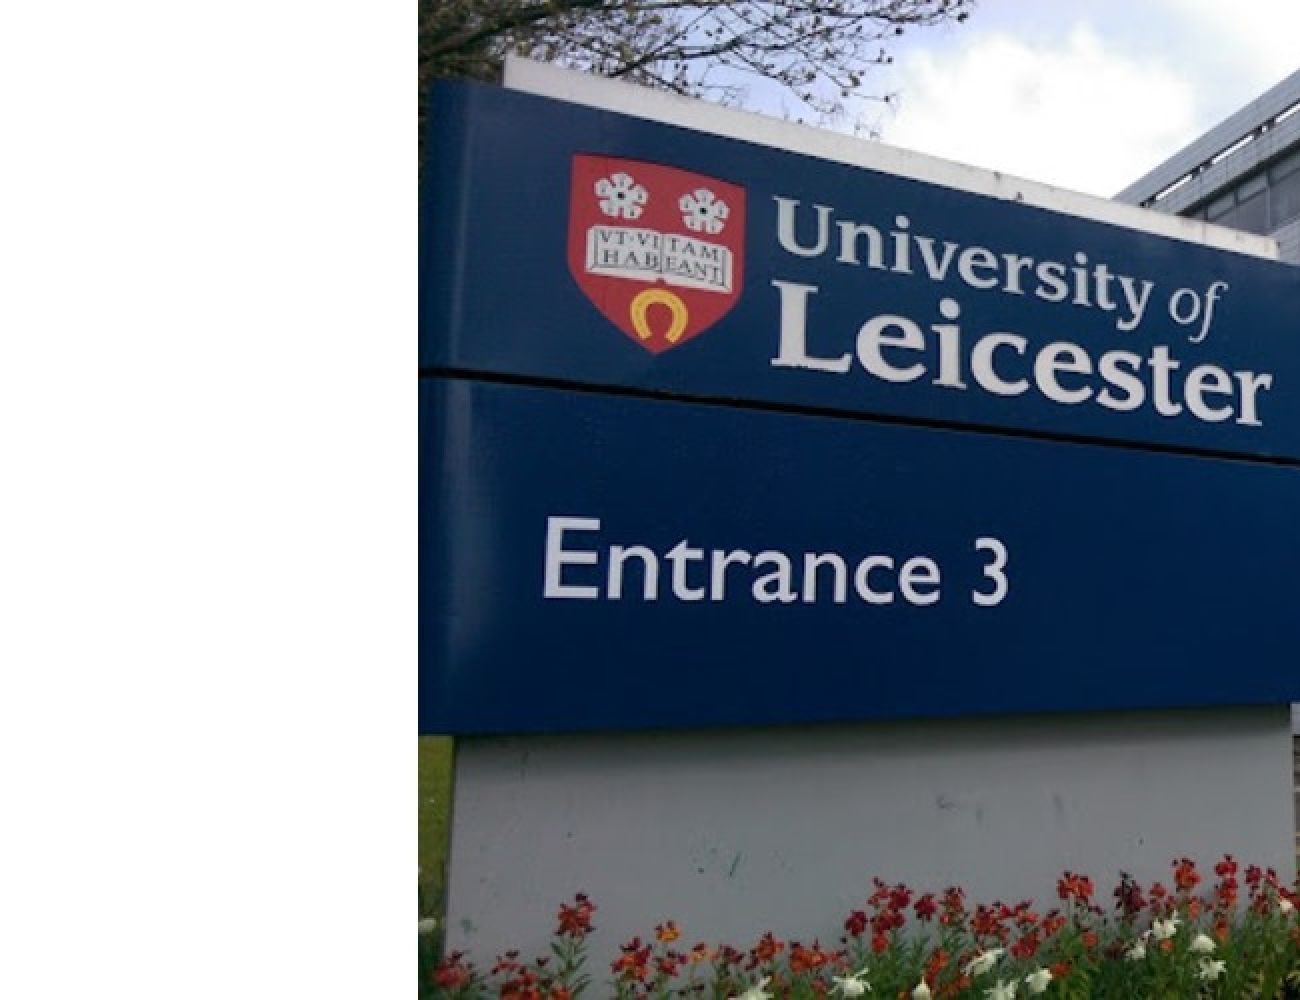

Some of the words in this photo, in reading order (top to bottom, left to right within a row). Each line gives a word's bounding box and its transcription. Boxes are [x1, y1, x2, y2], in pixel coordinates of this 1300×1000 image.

[773, 197, 1155, 331] University
[1168, 281, 1229, 343] of
[770, 279, 1274, 428] Leicester
[543, 516, 942, 606] Entrance
[972, 536, 1010, 607] 3
